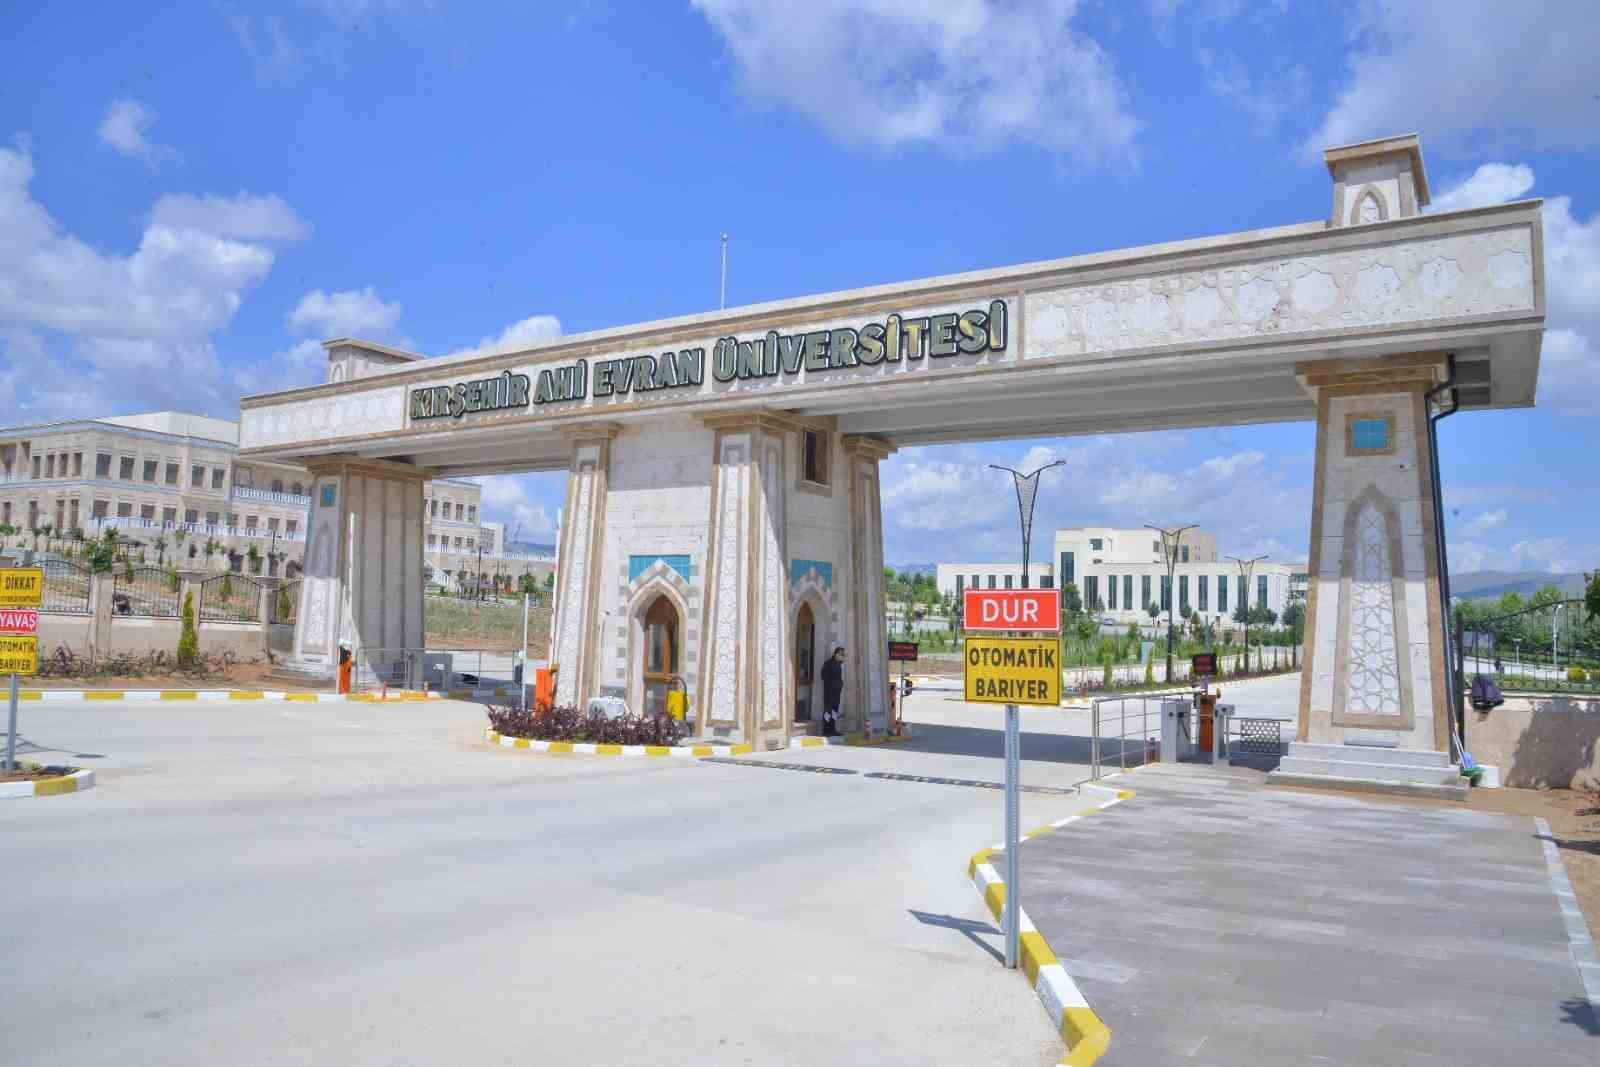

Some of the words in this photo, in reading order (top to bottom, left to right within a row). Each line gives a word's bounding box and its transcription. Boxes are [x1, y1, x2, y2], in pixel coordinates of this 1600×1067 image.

[410, 369, 530, 420] KIRŞEHİR
[533, 359, 588, 404] AHİ
[593, 348, 705, 397] EVRAN
[712, 299, 1008, 382] ÜNİVERSİTESİ
[0, 613, 36, 630] YAVAŞ
[982, 599, 1039, 623] DUR
[969, 645, 1055, 668] OTOMATİK
